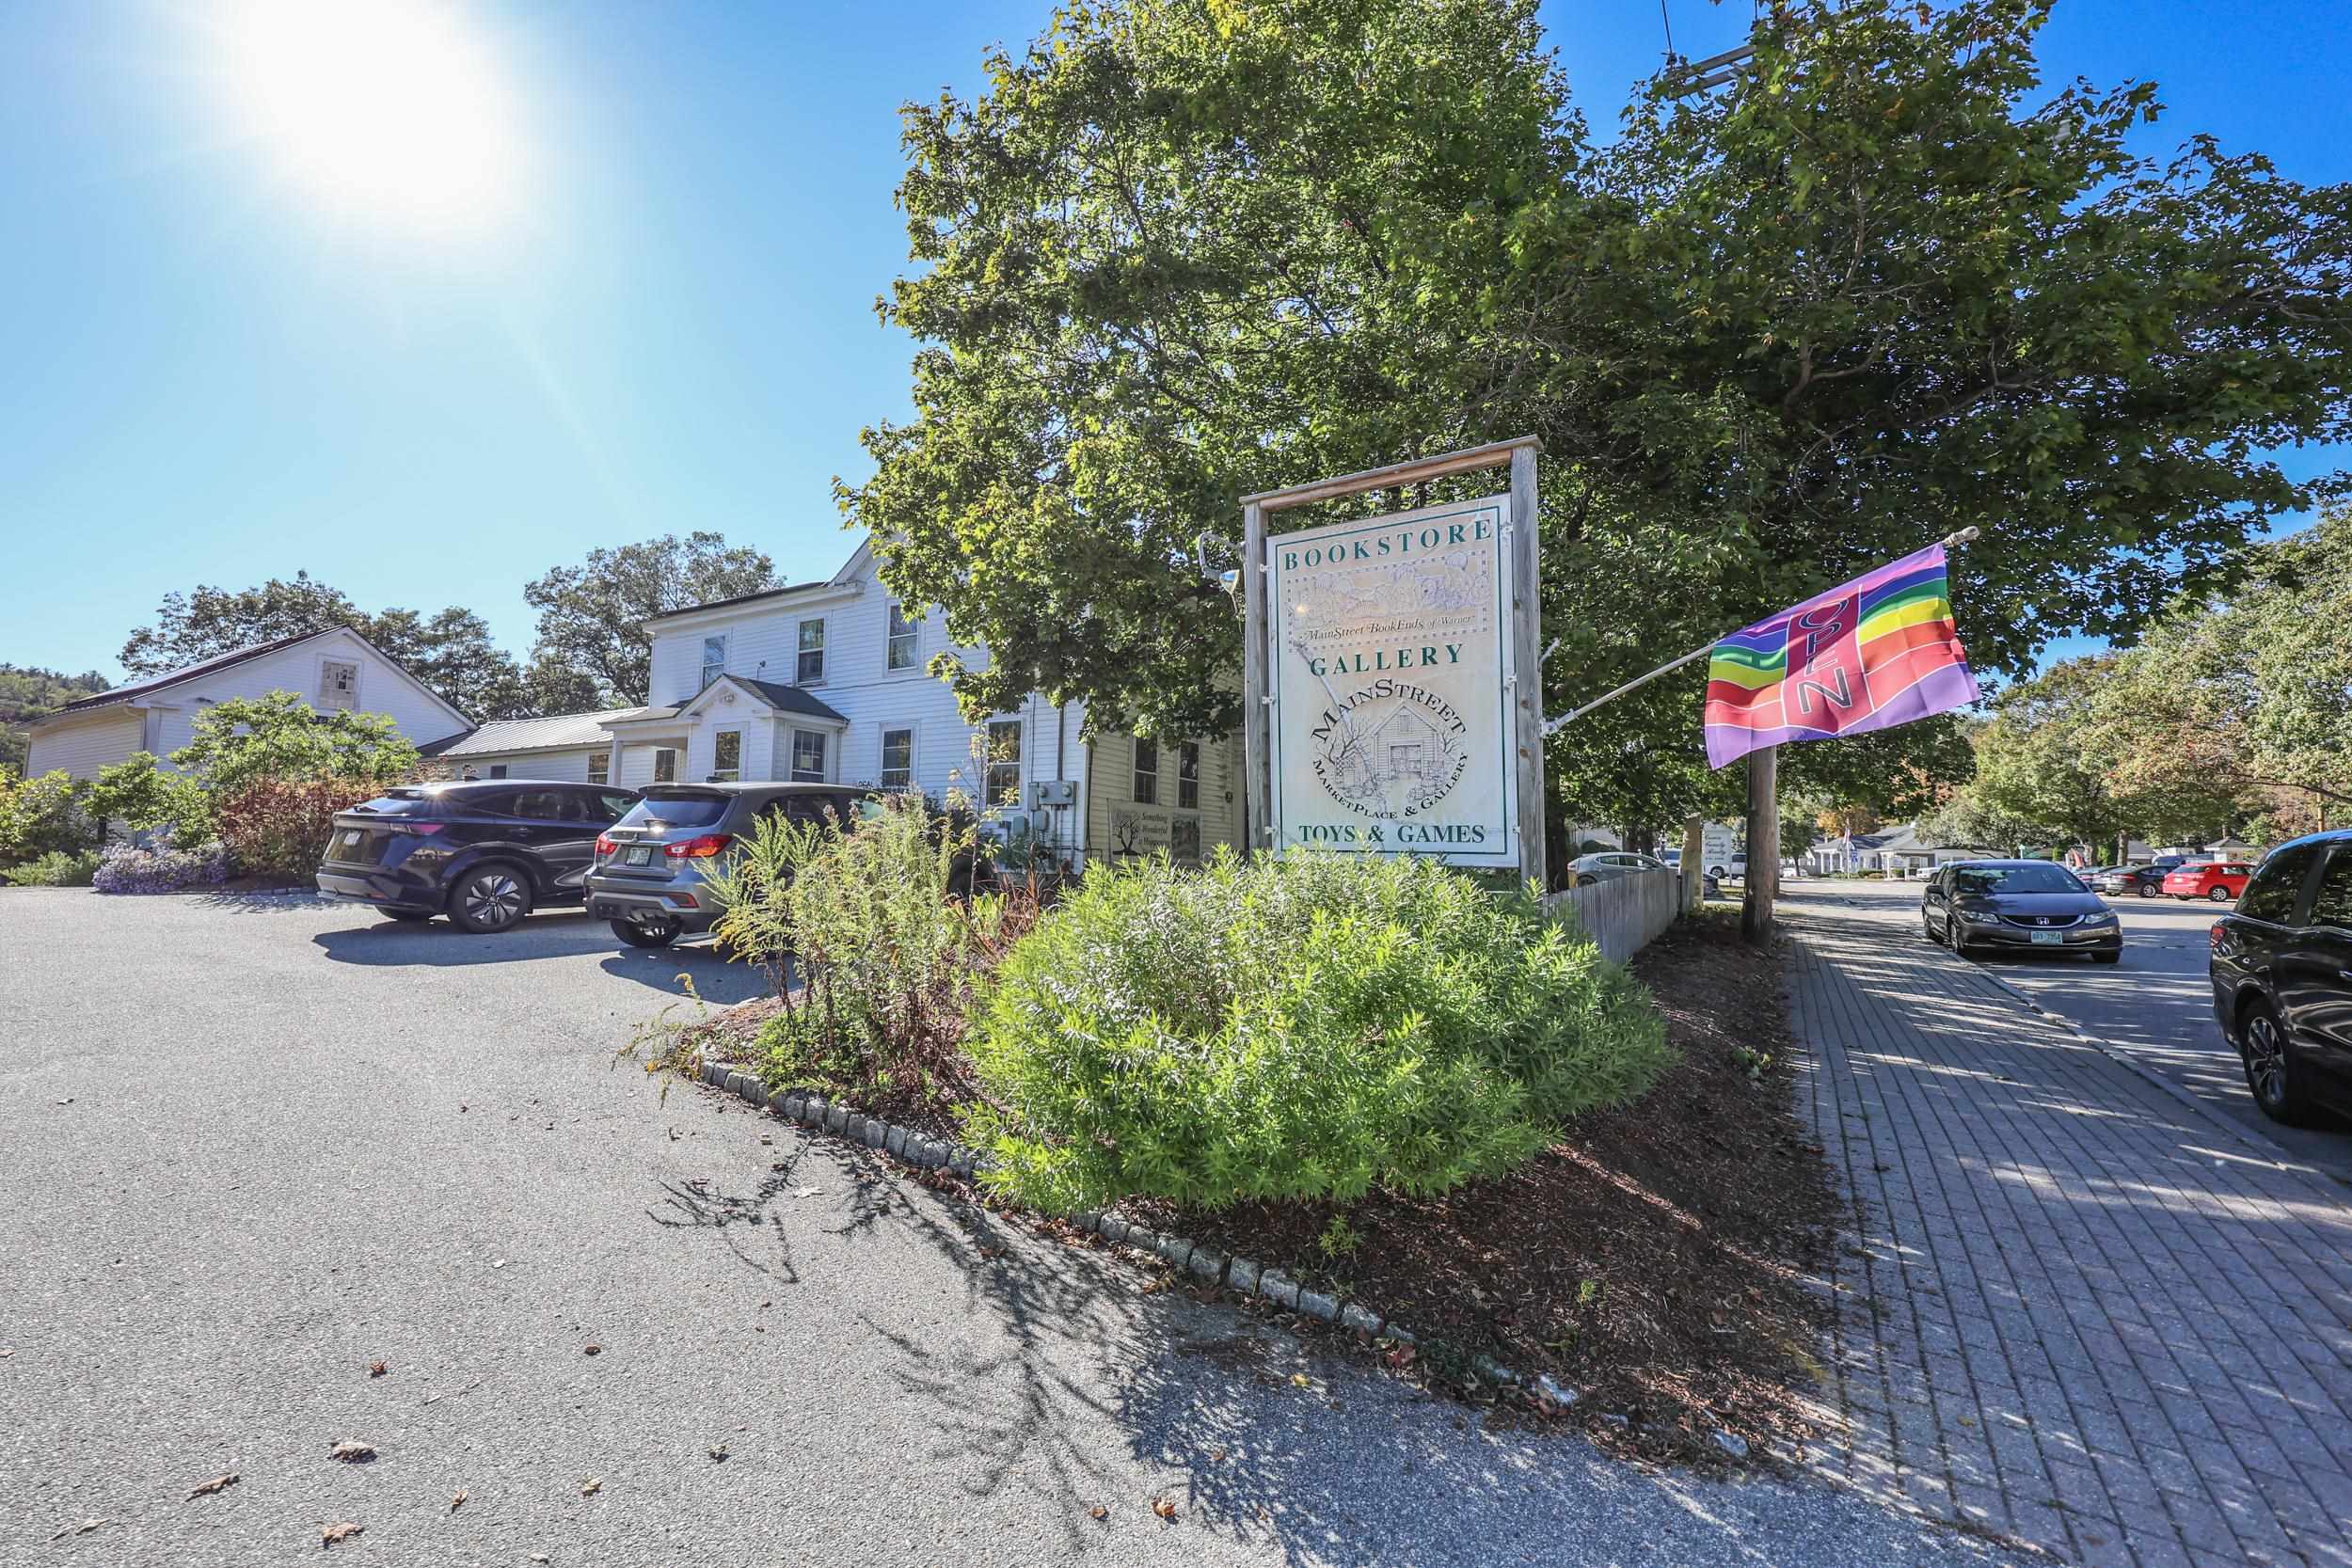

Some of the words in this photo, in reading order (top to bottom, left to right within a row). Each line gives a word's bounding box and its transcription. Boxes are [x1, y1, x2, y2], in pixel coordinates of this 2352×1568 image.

[1284, 518, 1491, 571] BOOKSTORE
[1310, 642, 1464, 677] GALLERY
[1797, 597, 1852, 714] OPEN
[1405, 805, 1418, 816] &
[1298, 824, 1356, 843] TOYS
[1367, 824, 1385, 843] &
[1397, 825, 1486, 844] GAMES
